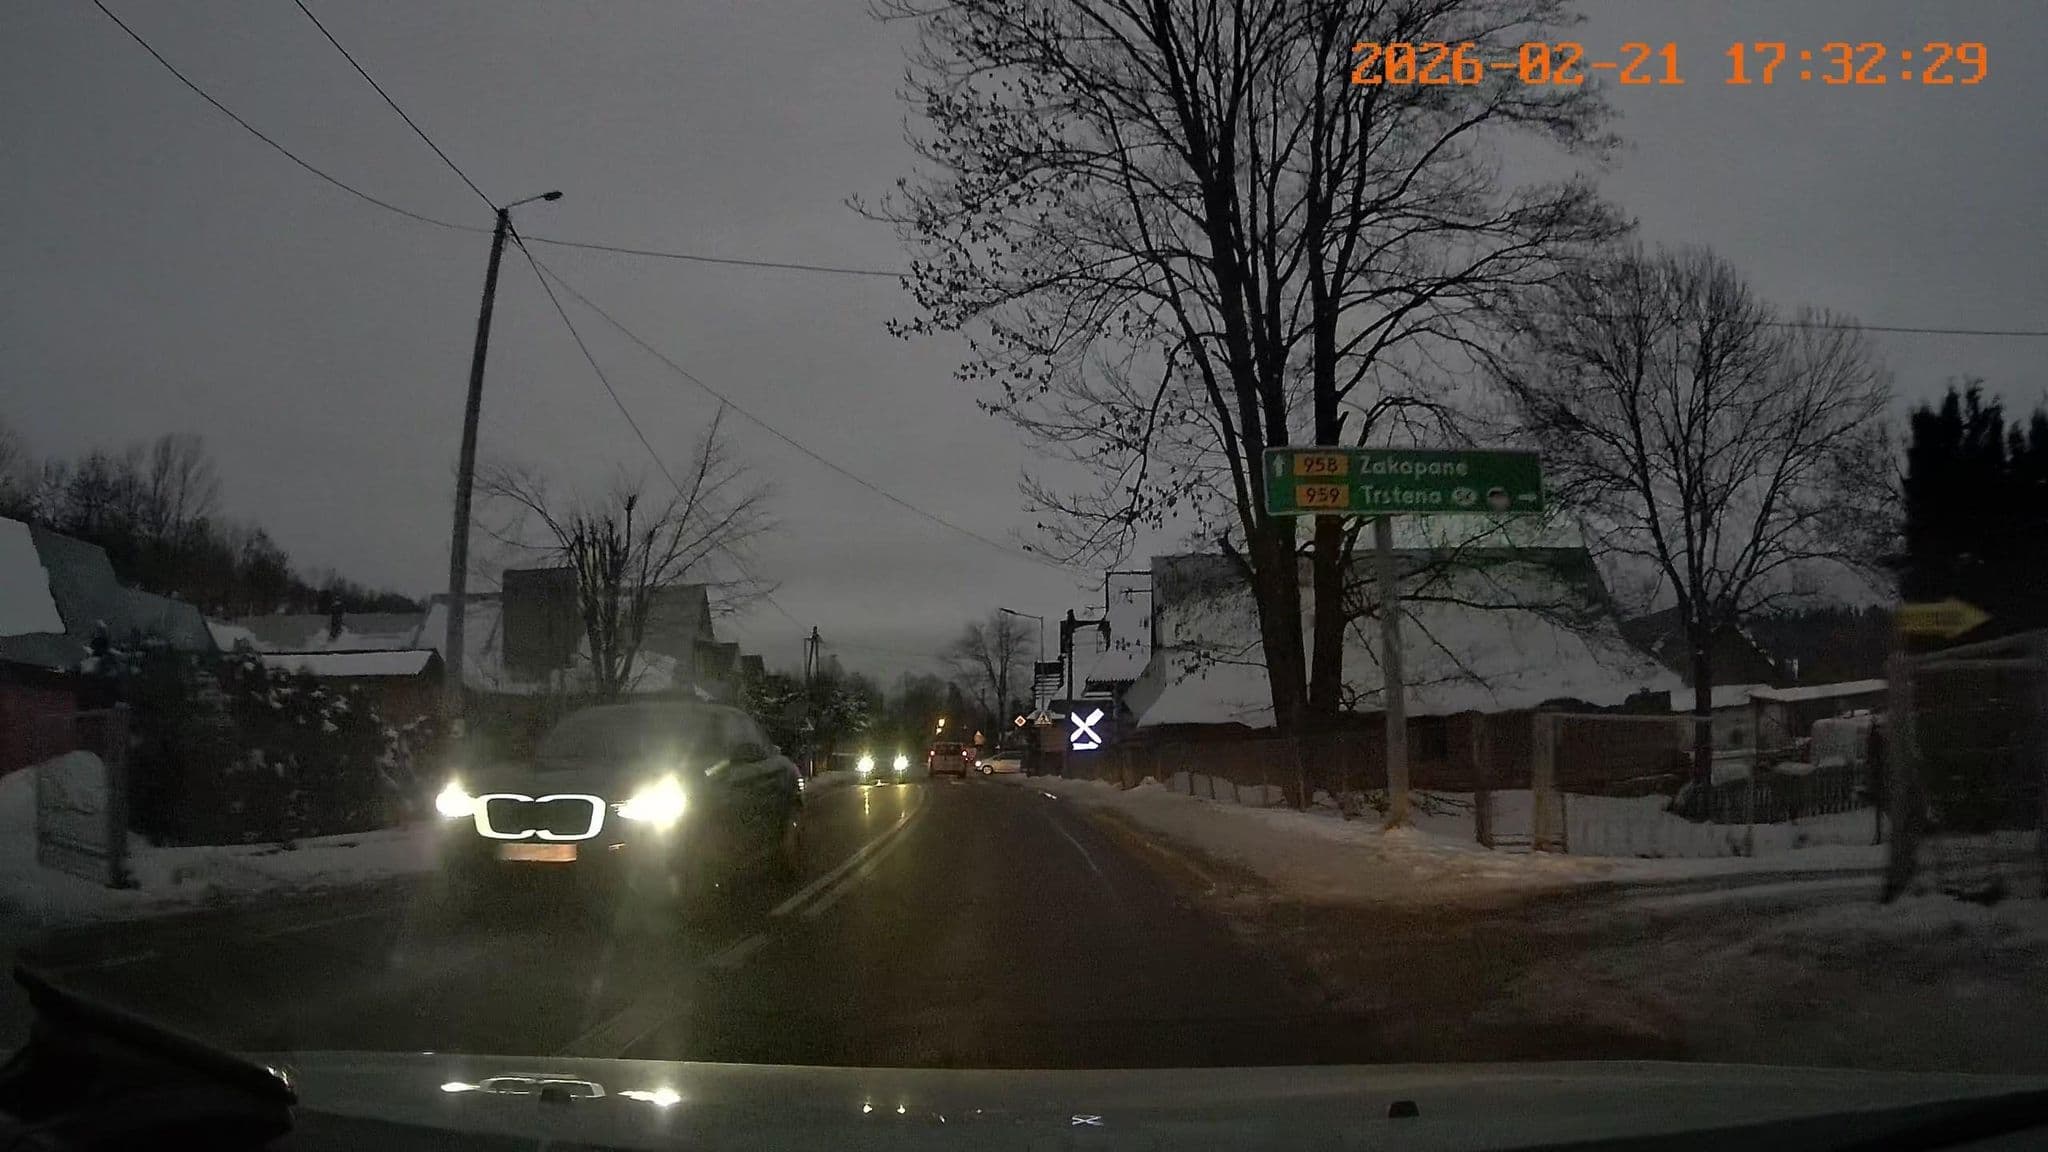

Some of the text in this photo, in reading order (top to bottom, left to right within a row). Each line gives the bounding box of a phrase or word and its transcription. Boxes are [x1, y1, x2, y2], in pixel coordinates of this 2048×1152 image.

[1302, 454, 1469, 480] 958 Zakopane
[1306, 486, 1342, 504] 959
[1360, 485, 1443, 506] Trstena
